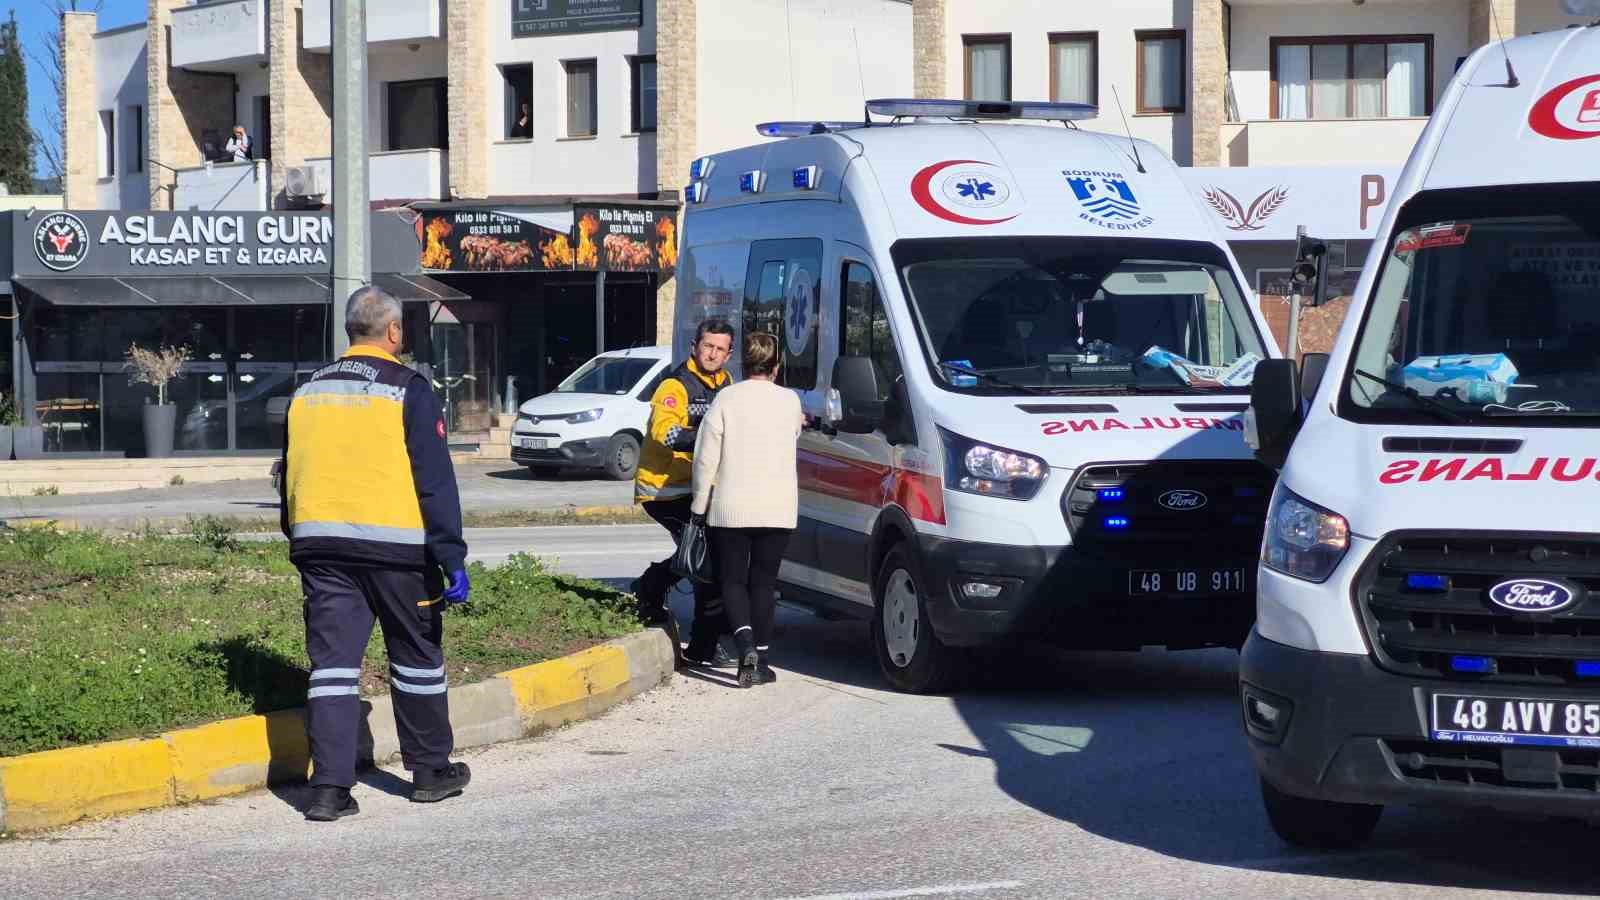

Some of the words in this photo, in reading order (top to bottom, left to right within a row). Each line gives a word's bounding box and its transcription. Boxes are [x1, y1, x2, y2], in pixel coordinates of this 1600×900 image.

[1062, 170, 1124, 179] BODRUM
[1360, 174, 1385, 230] P
[99, 215, 245, 244] ASLANCI
[130, 247, 201, 265] KASAP
[205, 248, 231, 264] ET
[236, 248, 251, 264] &
[257, 248, 328, 264] IZGARA
[1167, 493, 1199, 506] Ford
[1141, 573, 1161, 592] 48
[1176, 572, 1197, 591] UB
[1211, 571, 1240, 591] 911
[1504, 583, 1557, 606] Ford
[1453, 699, 1487, 729] 48
[1501, 701, 1553, 732] AVV
[1564, 703, 1600, 734] 85
